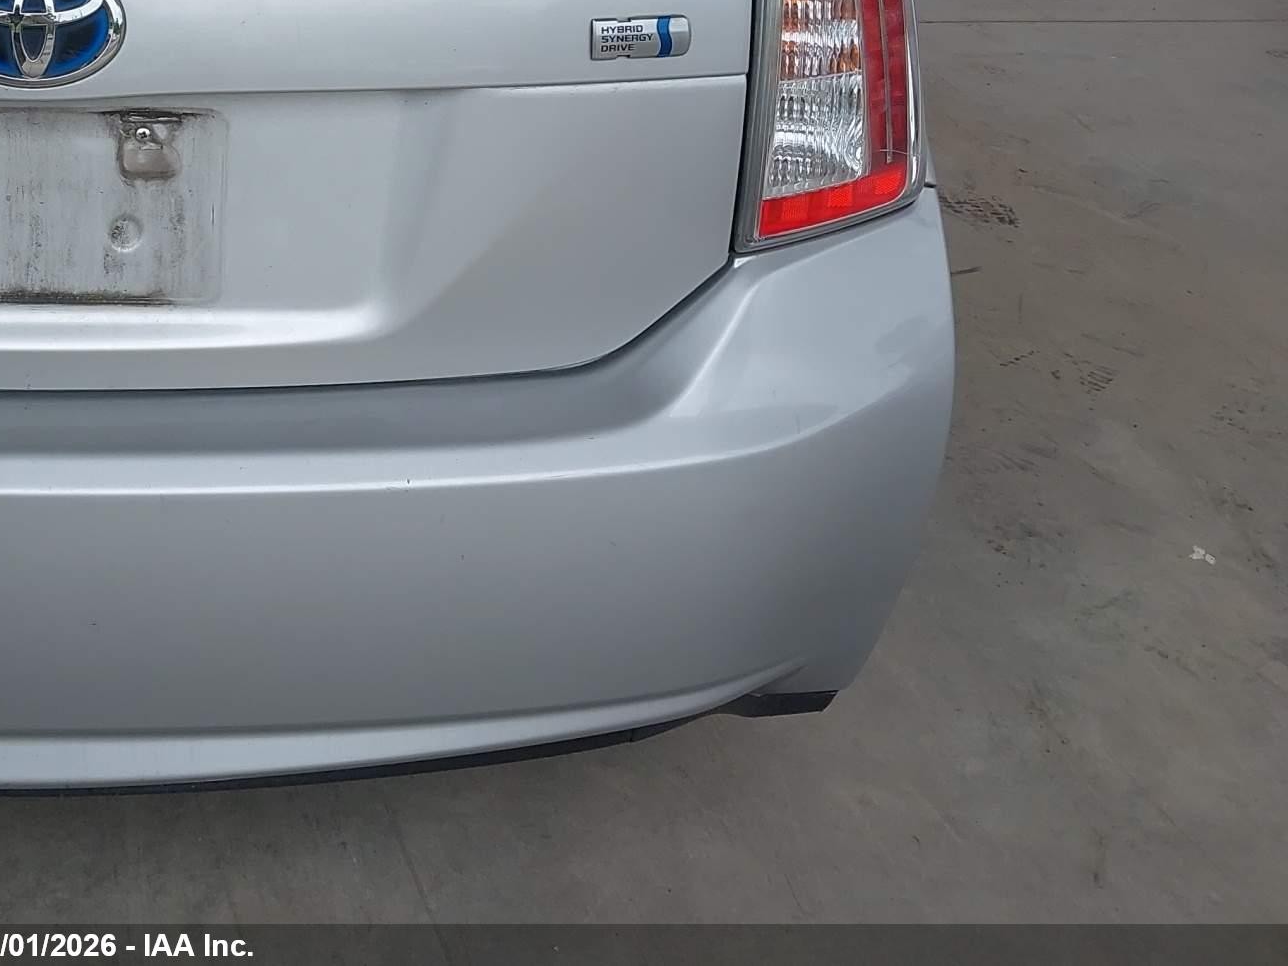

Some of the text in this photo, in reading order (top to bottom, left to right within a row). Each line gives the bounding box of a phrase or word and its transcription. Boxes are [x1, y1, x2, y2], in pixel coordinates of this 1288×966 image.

[601, 25, 643, 34] HYBRID
[601, 34, 653, 43] SYNERGY
[601, 44, 636, 52] DRIVE
